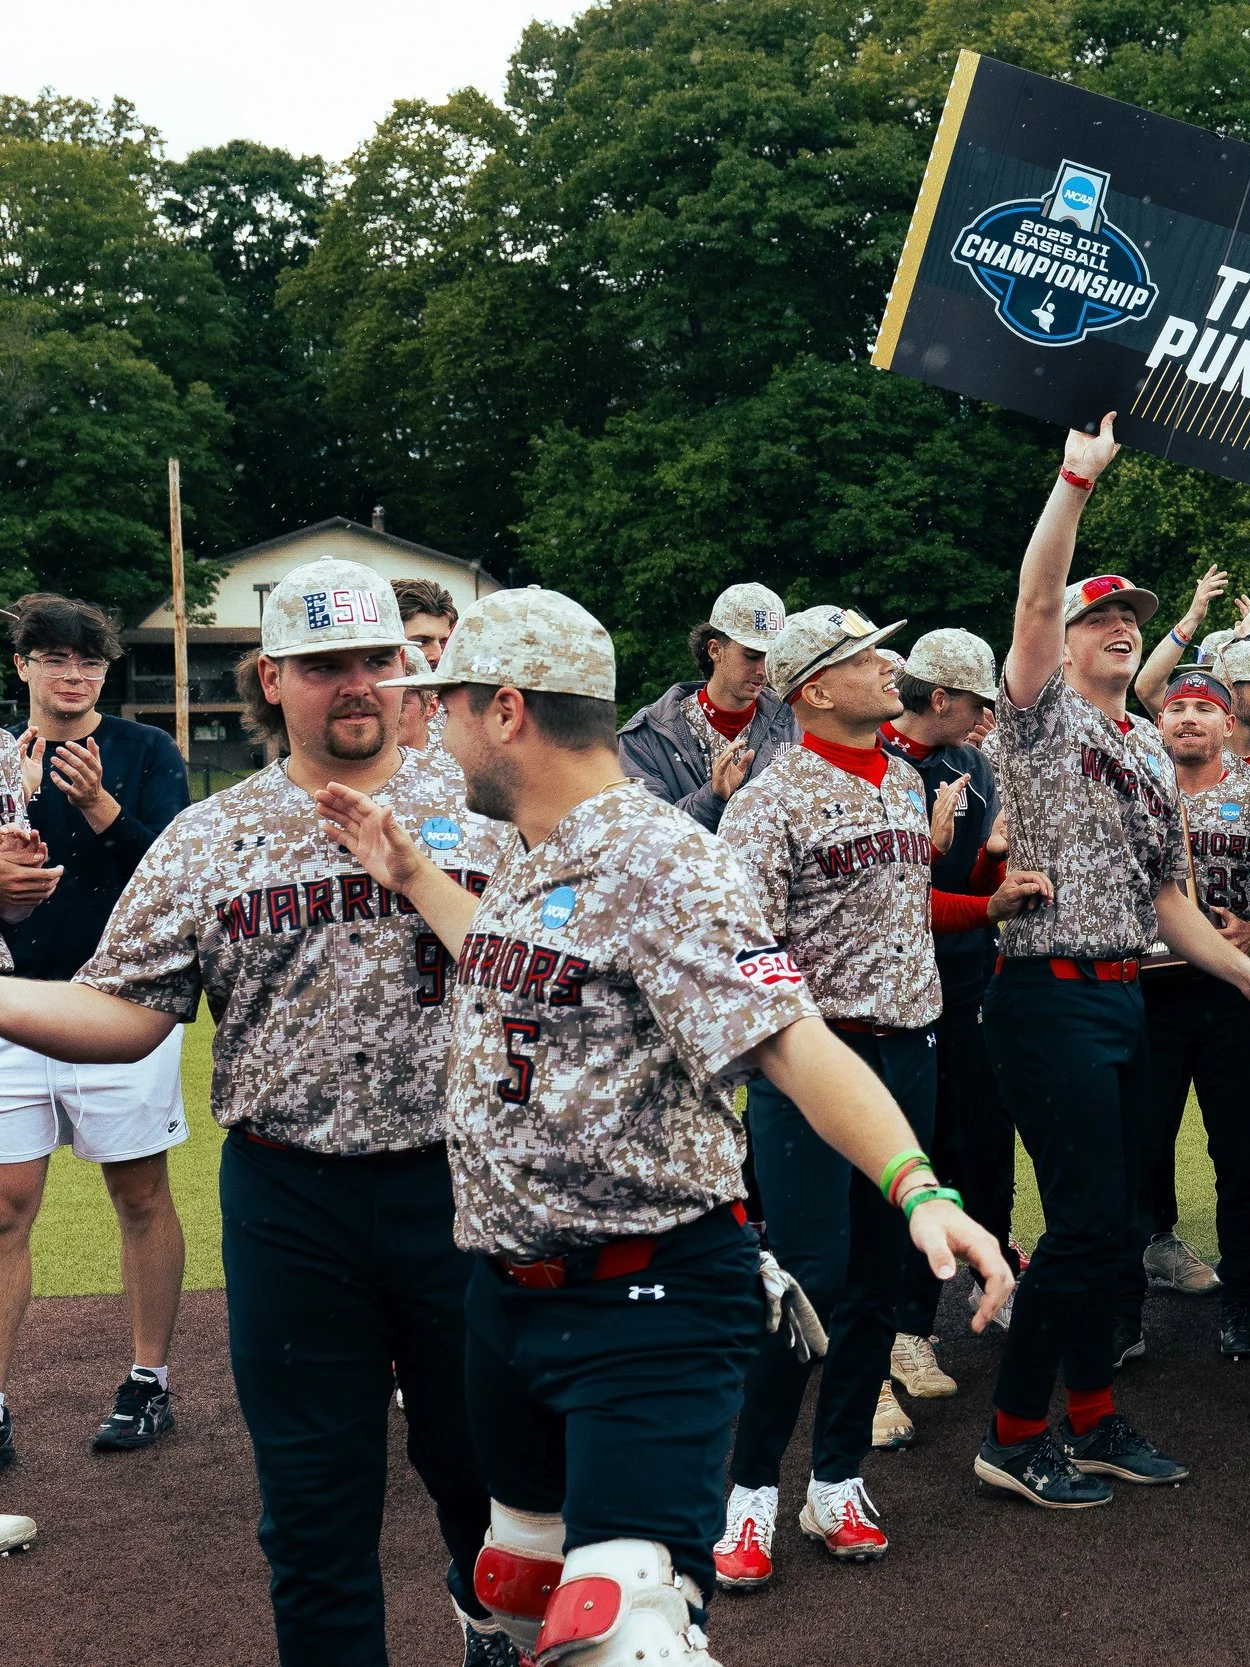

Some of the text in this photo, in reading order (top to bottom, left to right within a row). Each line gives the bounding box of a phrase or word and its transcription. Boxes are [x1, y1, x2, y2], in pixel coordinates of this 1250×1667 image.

[1063, 188, 1094, 206] NCAA
[1013, 231, 1109, 272] BASEBALL
[1020, 219, 1110, 258] 2025 DII
[960, 233, 1150, 310] CHAMPIONSHIP
[302, 589, 380, 631] ESU
[426, 830, 460, 842] NCAA
[1206, 866, 1249, 909] 25
[415, 932, 449, 1008] 9
[497, 1015, 541, 1106] 5
